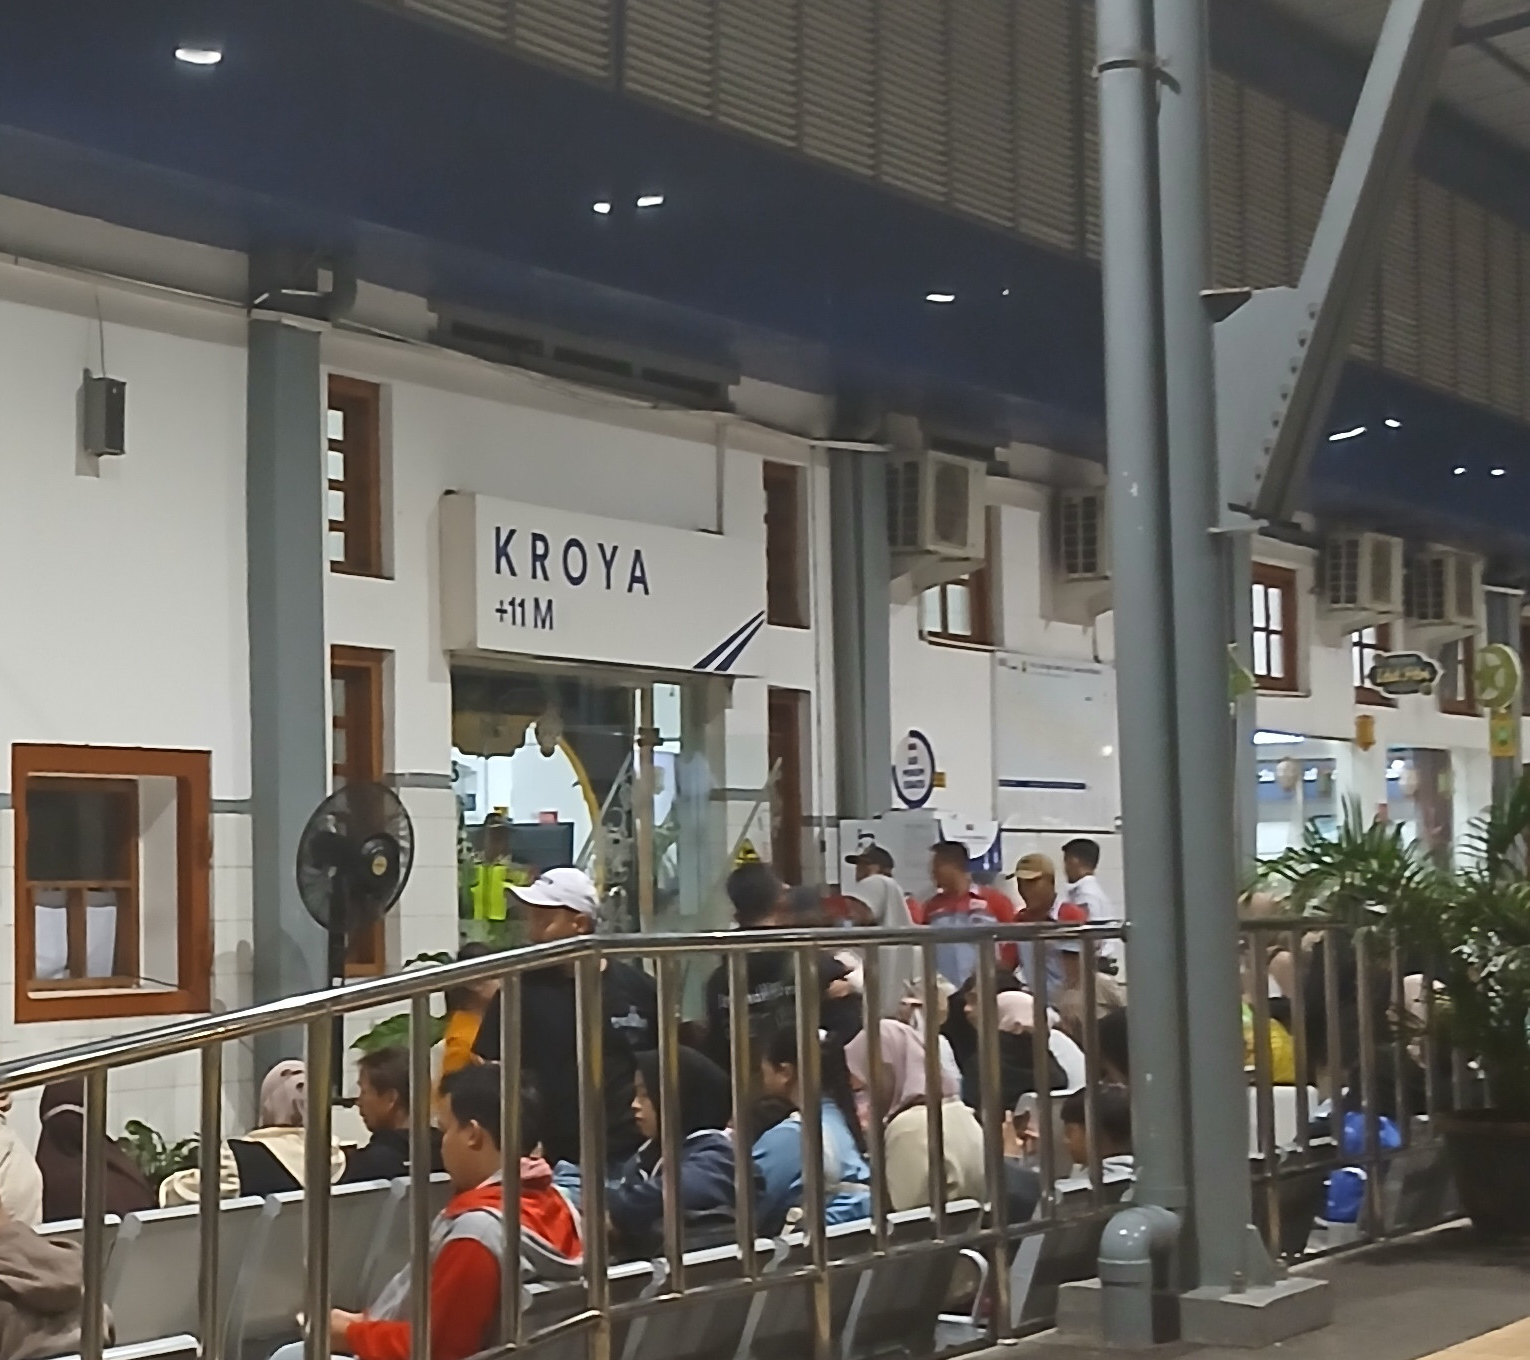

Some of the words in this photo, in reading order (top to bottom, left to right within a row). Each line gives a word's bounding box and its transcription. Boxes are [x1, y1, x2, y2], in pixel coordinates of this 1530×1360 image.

[495, 525, 650, 596] KROYA
[495, 596, 526, 628] +11
[533, 597, 554, 631] M
